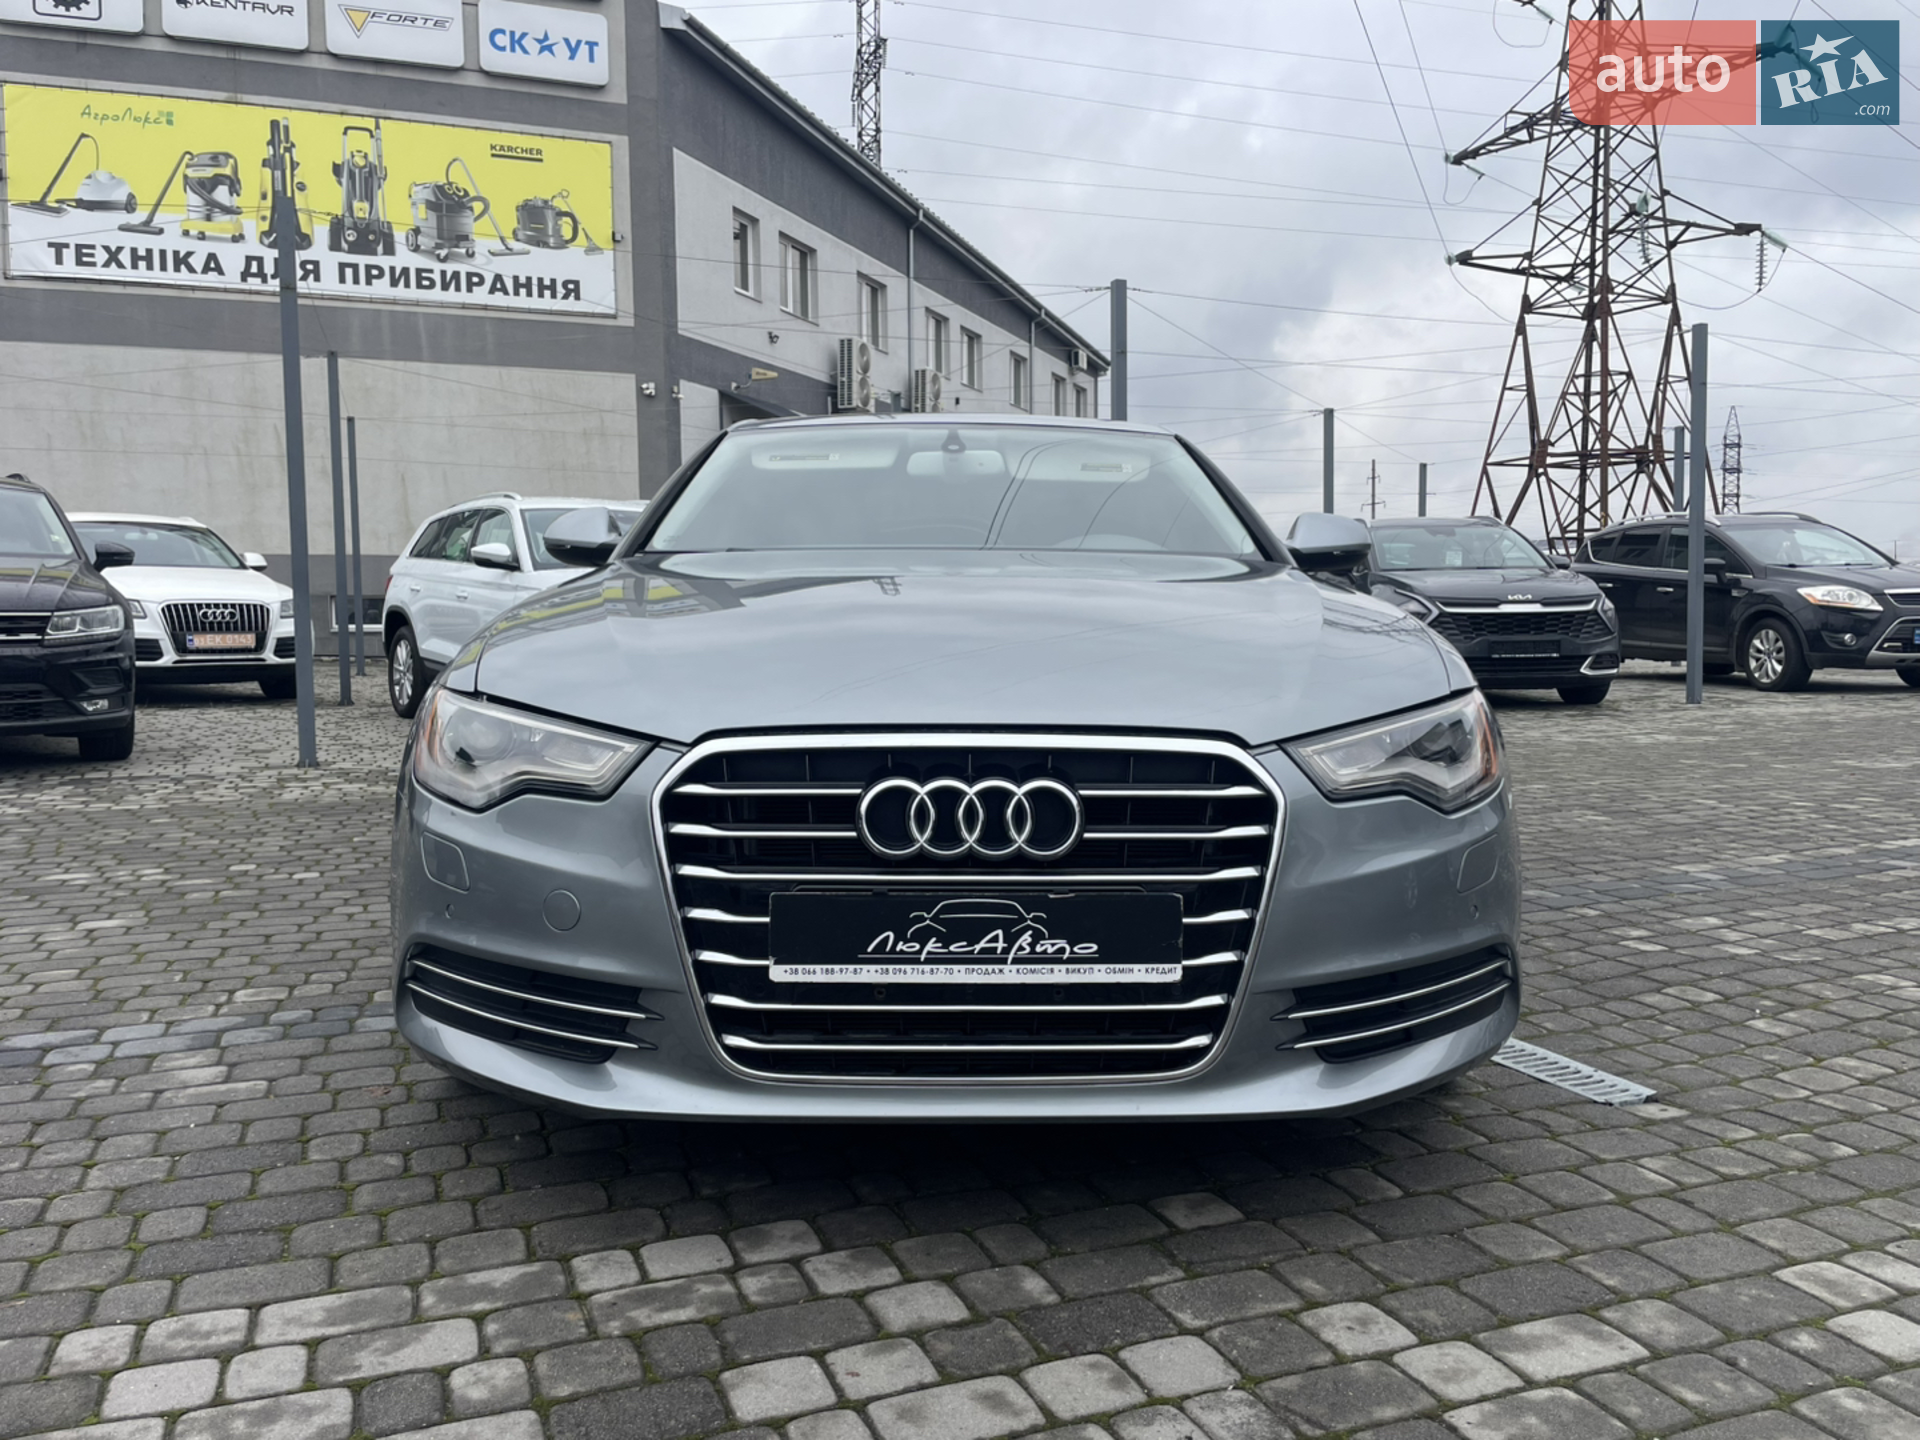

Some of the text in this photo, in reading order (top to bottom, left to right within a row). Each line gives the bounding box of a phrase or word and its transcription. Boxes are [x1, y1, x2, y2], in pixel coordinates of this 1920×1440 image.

[370, 11, 450, 29] FORTE
[47, 241, 226, 276] ТЕХНІКА
[337, 261, 581, 301] ПРИБИРАННЯ
[783, 966, 1177, 976] +38 066 188-97-87 +38 096 716-87-70 ПРОДАЖ КОМІСІЯ ВИКУП ОБМІН КРЕДИТ
